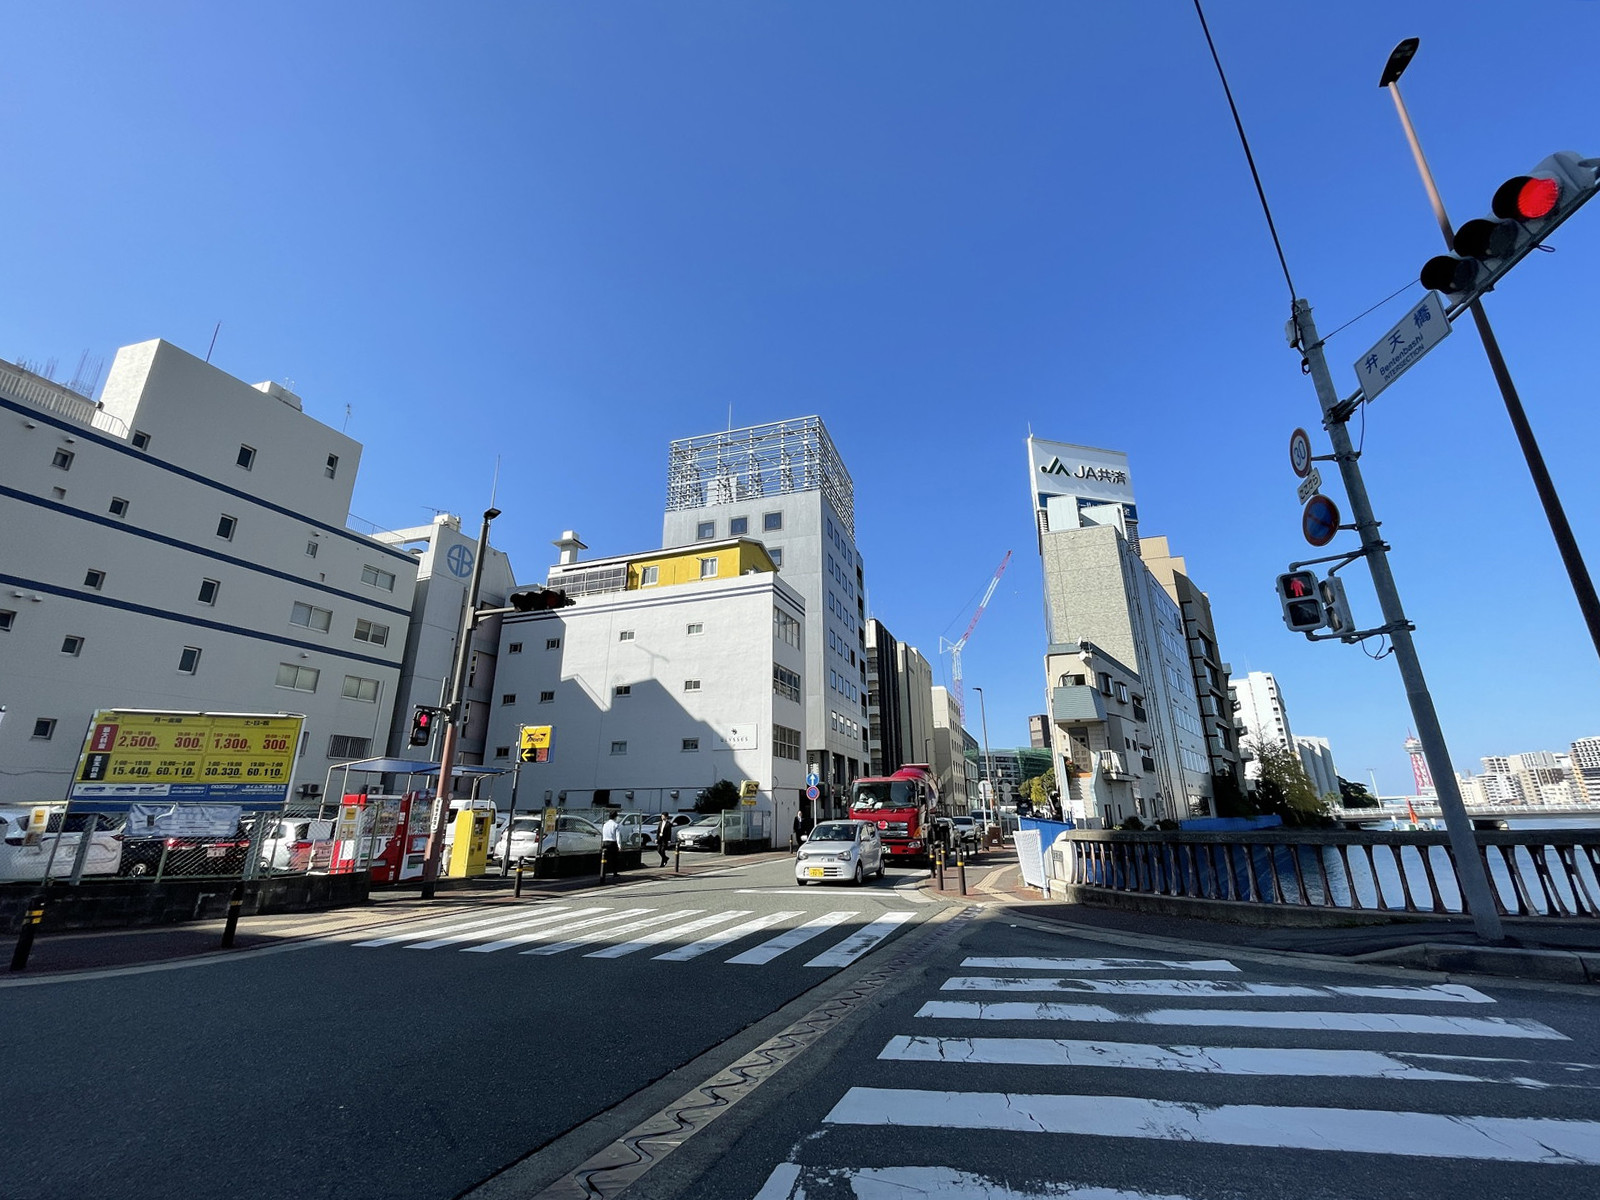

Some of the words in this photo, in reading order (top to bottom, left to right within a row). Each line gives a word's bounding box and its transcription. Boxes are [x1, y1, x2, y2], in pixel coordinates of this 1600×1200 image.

[1365, 304, 1431, 374] 弁天橋
[1379, 332, 1424, 376] Bentenbashi
[1383, 343, 1425, 381] INTERSECTION
[1294, 440, 1306, 467] 30
[1073, 465, 1127, 485] JA共済
